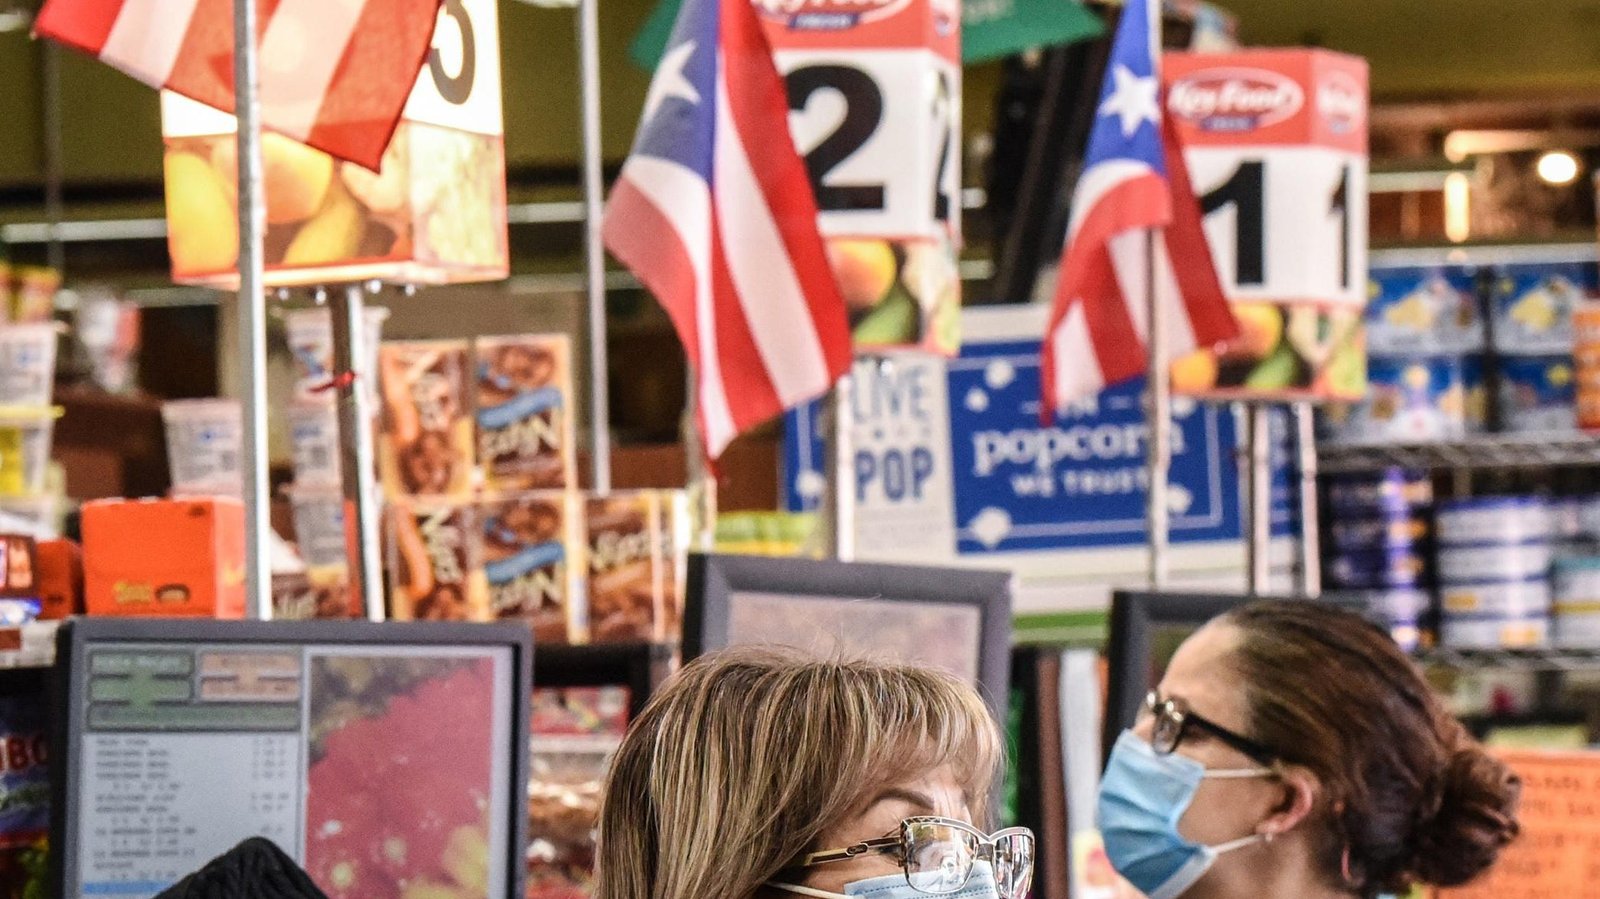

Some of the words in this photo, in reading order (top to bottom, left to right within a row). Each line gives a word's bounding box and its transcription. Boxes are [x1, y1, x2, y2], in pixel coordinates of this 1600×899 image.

[786, 64, 885, 212] 2
[1198, 160, 1265, 284] 1
[1331, 163, 1350, 289] 1
[855, 446, 934, 505] POP
[1011, 472, 1055, 498] WE
